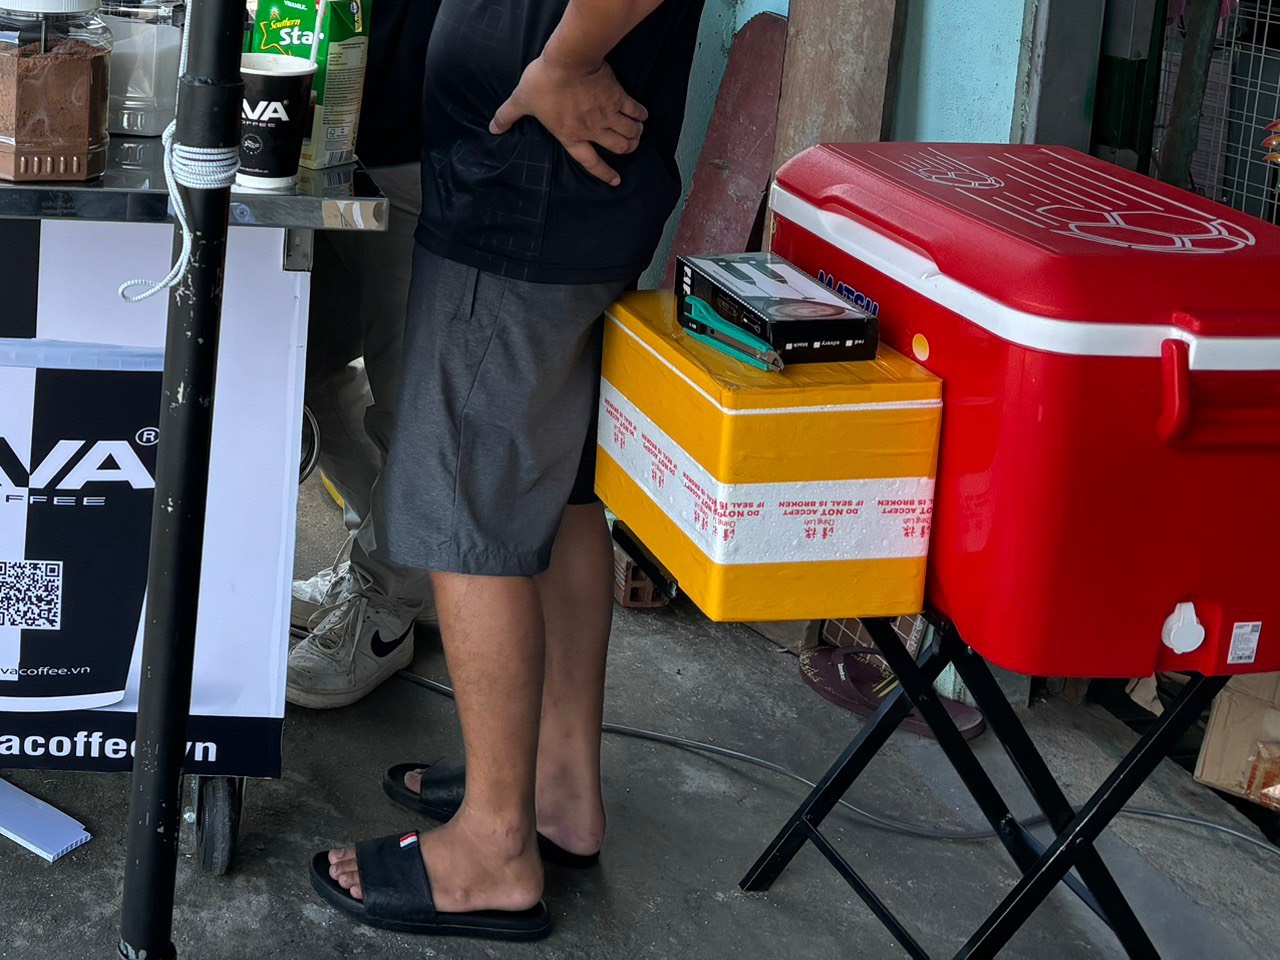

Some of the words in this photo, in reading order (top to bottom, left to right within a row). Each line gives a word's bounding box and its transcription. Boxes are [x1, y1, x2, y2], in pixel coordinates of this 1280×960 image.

[270, 17, 301, 30] Southern
[241, 98, 290, 121] VA
[241, 120, 276, 128] OFFEE
[778, 500, 817, 508] BROKEN
[877, 499, 915, 507] BROKEN
[783, 508, 818, 516] ACCEPT
[821, 508, 843, 516] NOT
